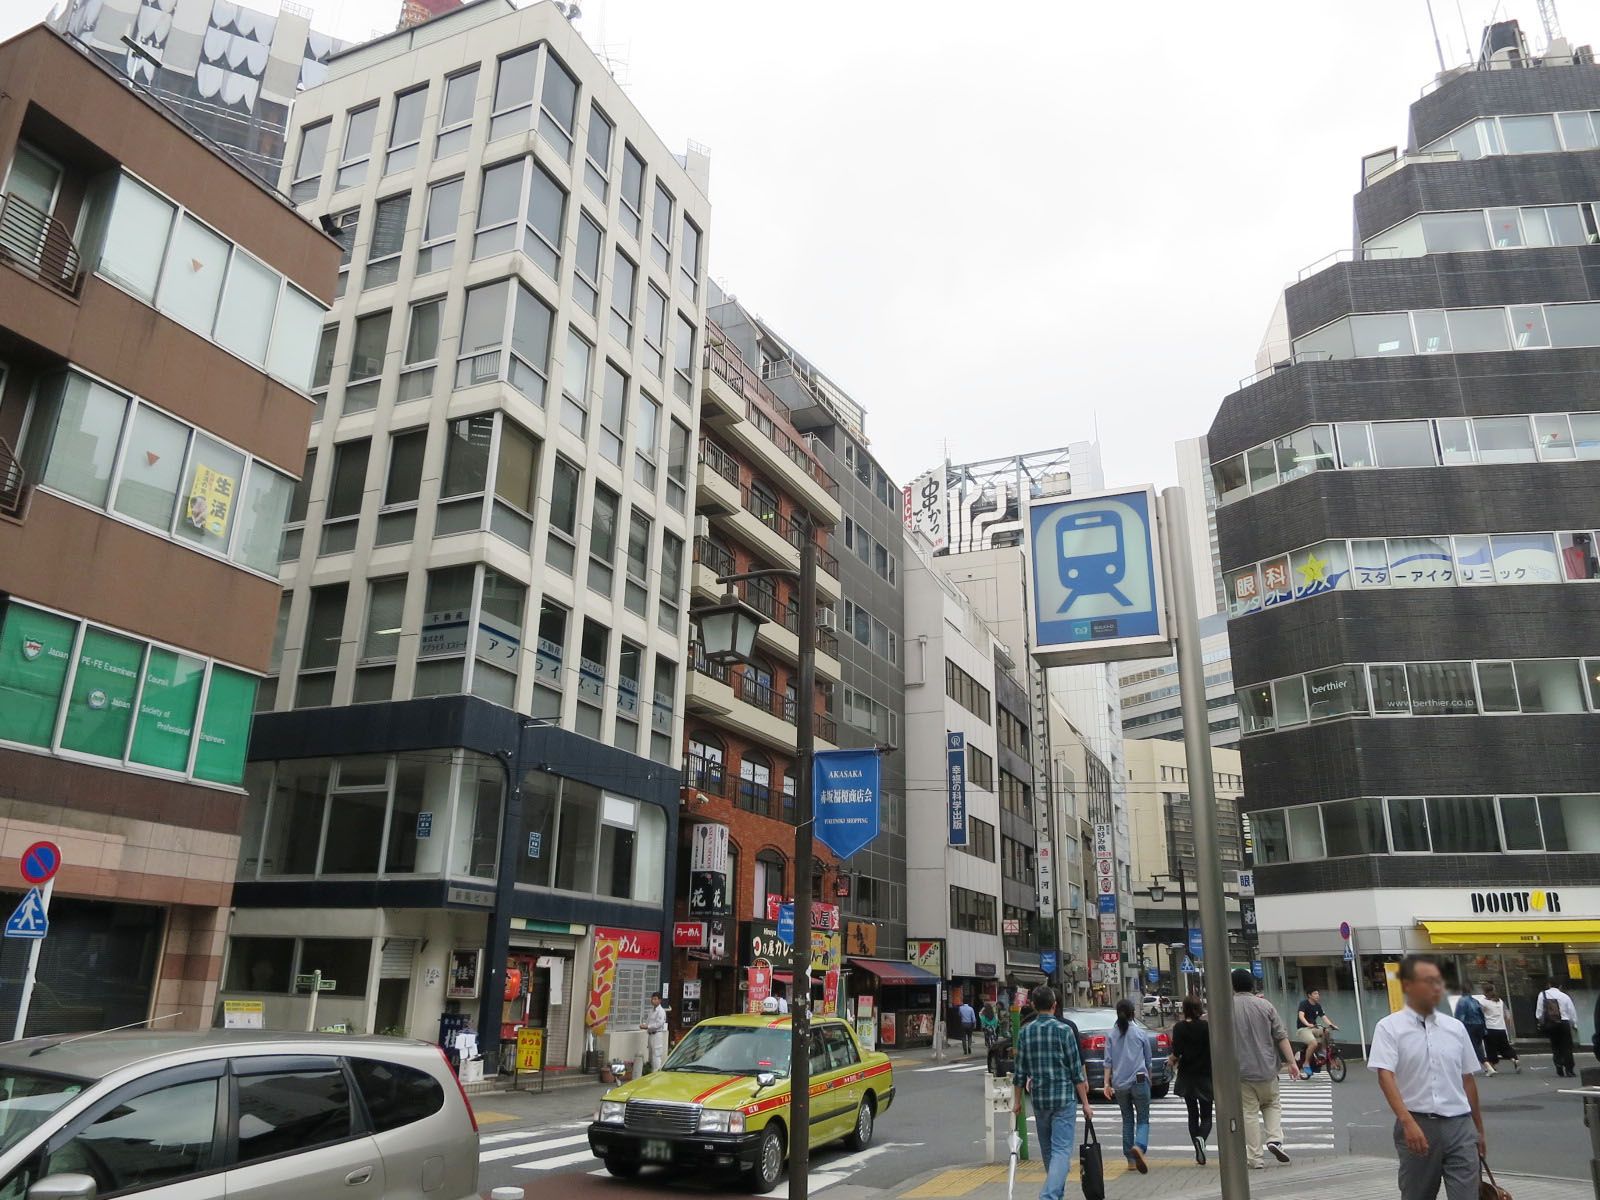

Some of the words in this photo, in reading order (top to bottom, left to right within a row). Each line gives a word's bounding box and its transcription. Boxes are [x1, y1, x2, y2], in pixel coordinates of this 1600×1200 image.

[1236, 564, 1287, 597] 眼科
[1361, 567, 1526, 584] スターアイクリニック
[48, 647, 69, 660] Japan
[104, 662, 137, 679] Examiners
[147, 674, 169, 687] Council
[1311, 680, 1348, 695] berthier
[111, 696, 131, 709] Japan
[141, 704, 162, 718] Society
[163, 710, 171, 718] of
[1387, 698, 1474, 710] www.berthier.co.jp
[156, 721, 190, 737] Professional
[199, 731, 226, 745] Engineers
[828, 770, 863, 779] AKASAKA
[1040, 866, 1049, 905] 三河屋
[1470, 889, 1561, 913] DOUTOR
[676, 928, 700, 937] らーめん
